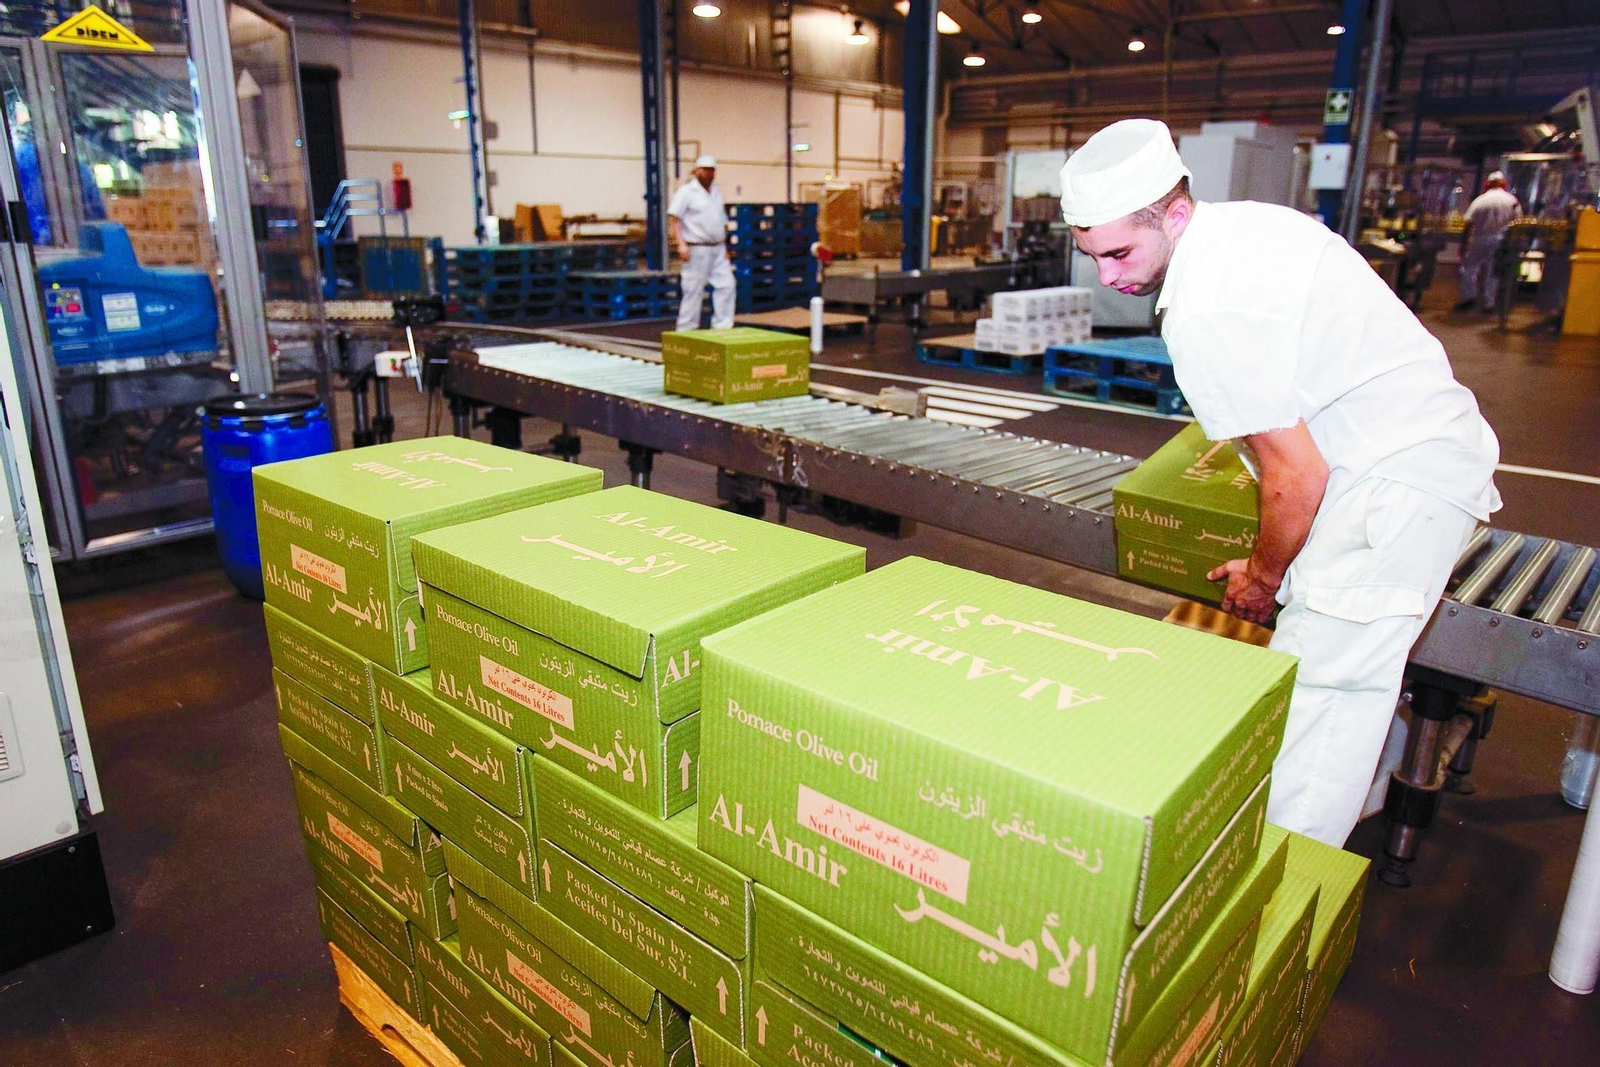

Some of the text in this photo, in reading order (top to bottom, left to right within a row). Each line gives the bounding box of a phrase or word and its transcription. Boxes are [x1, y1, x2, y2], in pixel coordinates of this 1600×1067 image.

[262, 499, 313, 532] Pomace Olive Oil
[593, 511, 738, 555] Al-Amir
[1117, 502, 1183, 530] Al-Amir
[519, 532, 691, 579] الأمير
[265, 561, 313, 603] Al-Amir
[327, 587, 389, 633] الأمير
[436, 604, 519, 657] Pomace Olive Oil
[539, 653, 638, 707] زيت متبقي الزيتون
[865, 627, 1106, 712] Al-Amir
[380, 686, 436, 738] Al-Amir
[436, 667, 515, 731] Al-Amir
[487, 674, 565, 722] Net Contents 16 Litres
[446, 740, 506, 786] الأمير
[539, 723, 647, 788] الأمير
[726, 697, 878, 781] Pomace Olive Oil
[406, 775, 449, 812] Packed in Spain
[304, 815, 350, 866] Al-Amir
[593, 818, 621, 841] للتموين
[708, 793, 848, 888] Al-Amir
[808, 813, 948, 893] Net Contents 16 Litres
[918, 780, 1104, 875] زيت متبقي الزيتون
[644, 849, 667, 867] عصام
[670, 860, 694, 885] شركة
[365, 865, 426, 919] الأمير
[566, 870, 692, 964] Packed in Spain by:
[664, 885, 687, 906] هاتف
[703, 906, 721, 927] جدة
[704, 885, 730, 907] الوكيل
[466, 894, 543, 964] Pomace Olive Oil
[565, 887, 697, 987] Aceites Del Sur, S.L.
[892, 885, 1097, 999] الأمير
[418, 940, 471, 999] Al-Amir
[467, 945, 538, 1017] Al-Amir
[559, 969, 592, 998] الزيتون
[480, 1010, 538, 1062] الأمير
[624, 1014, 648, 1040] زيت
